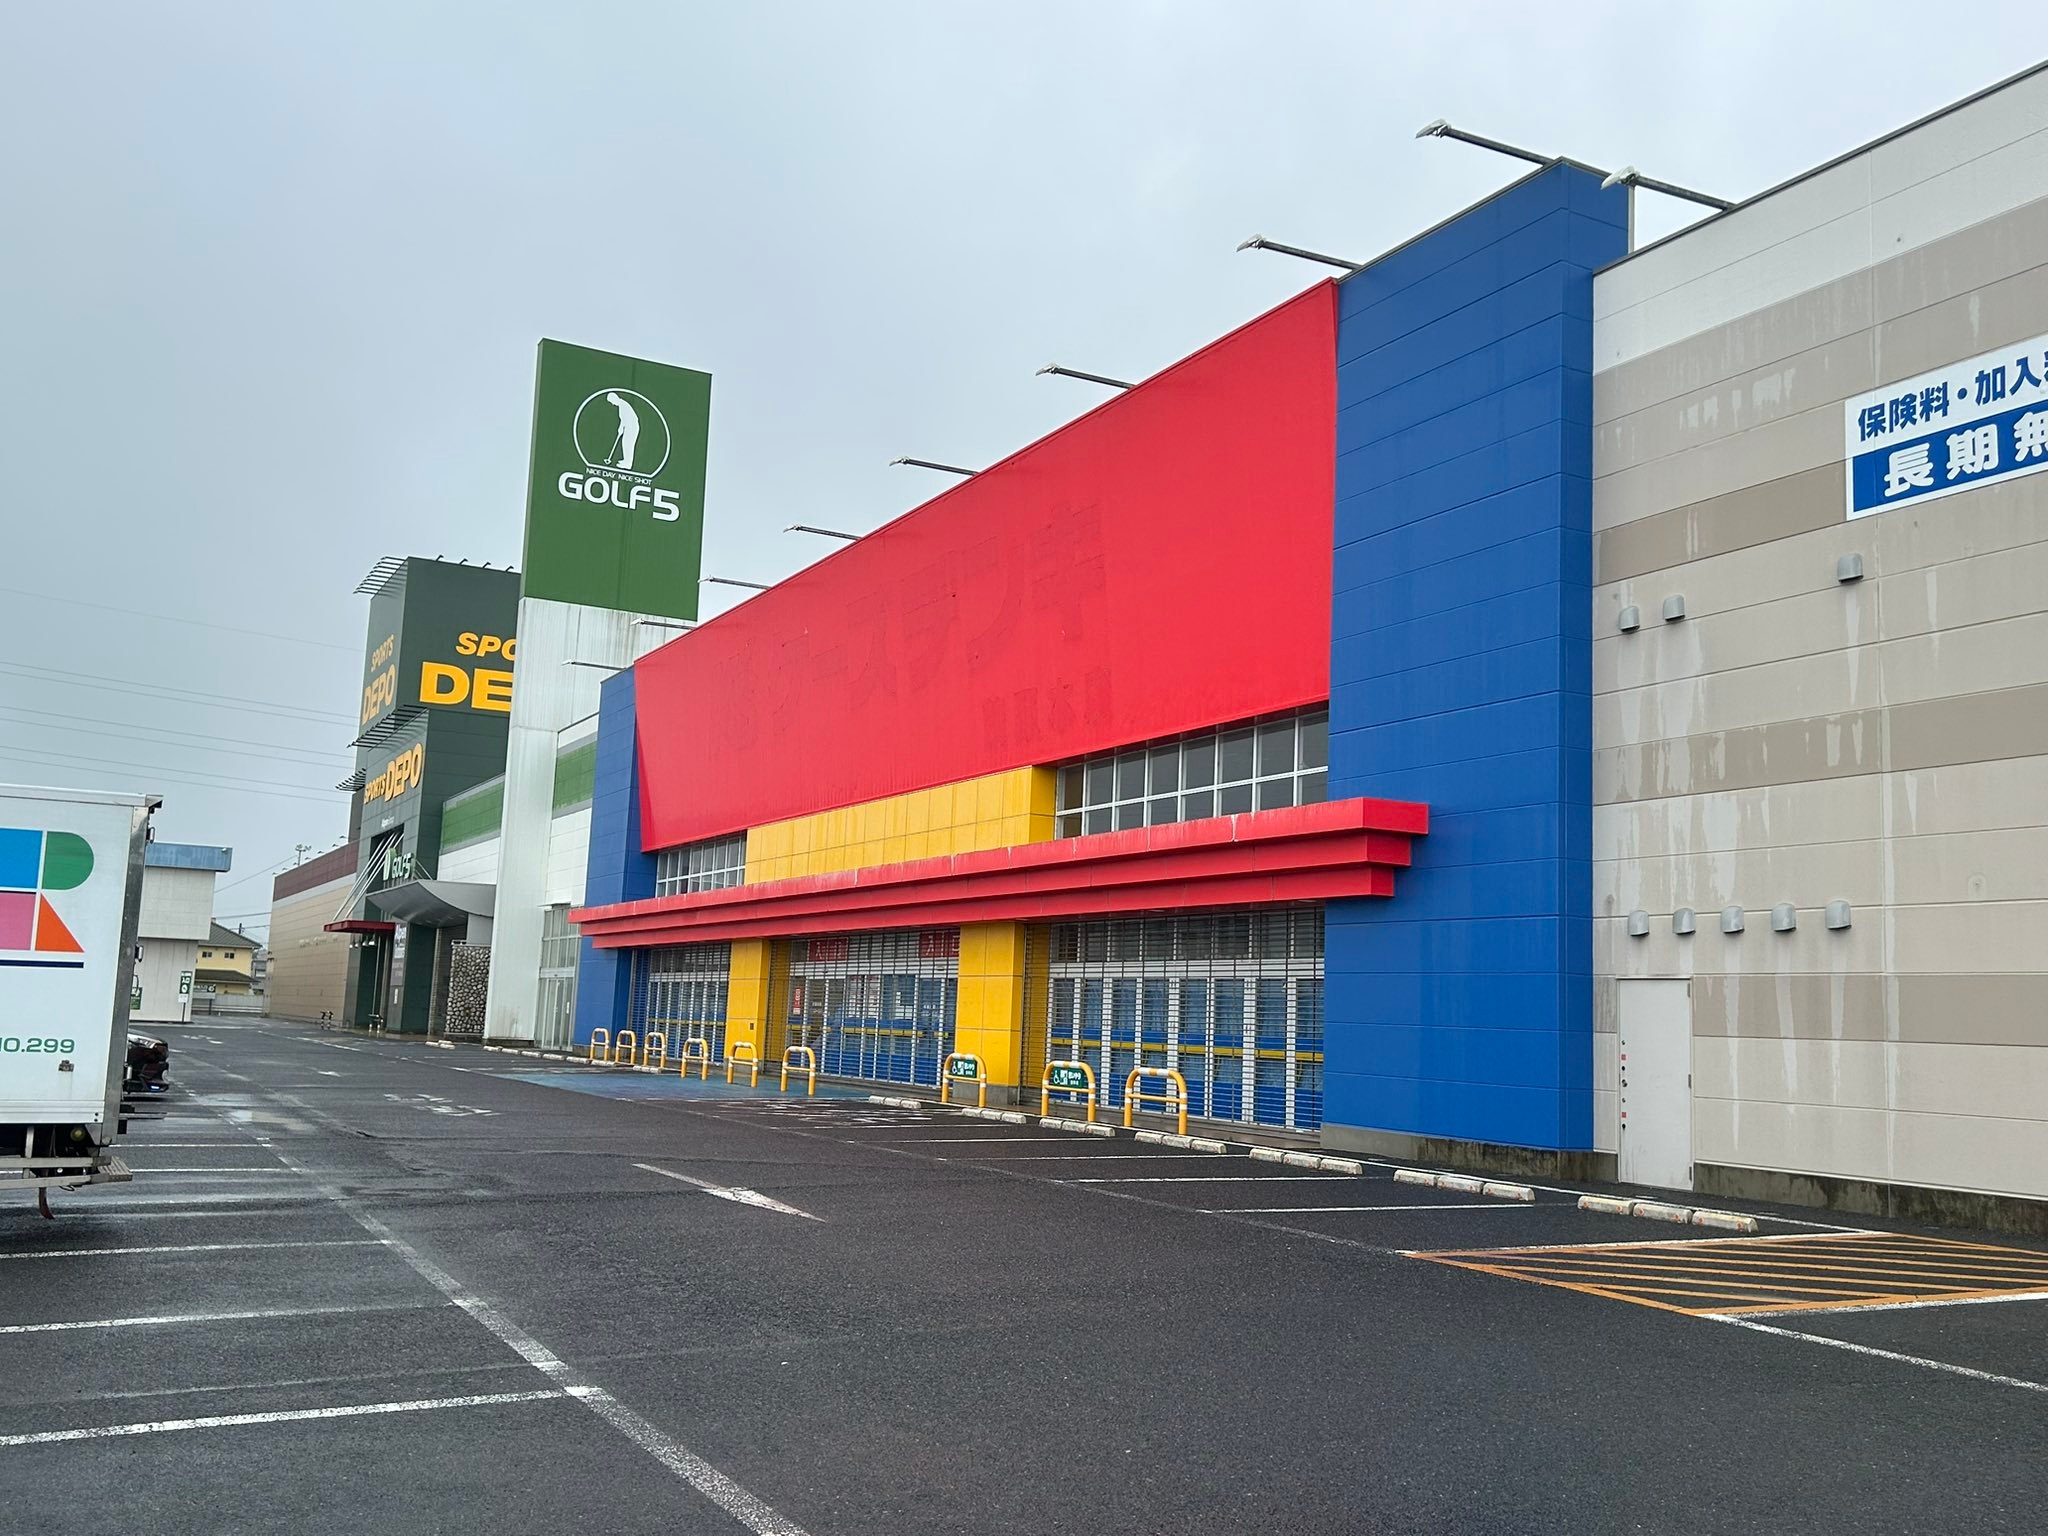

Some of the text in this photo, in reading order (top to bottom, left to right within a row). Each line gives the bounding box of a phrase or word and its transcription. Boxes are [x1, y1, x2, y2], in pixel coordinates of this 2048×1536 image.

[558, 471, 680, 522] GOLF5
[585, 467, 652, 486] NICE DAY NICE SHOT
[362, 664, 396, 725] DEPO
[384, 743, 423, 802] DEPO
